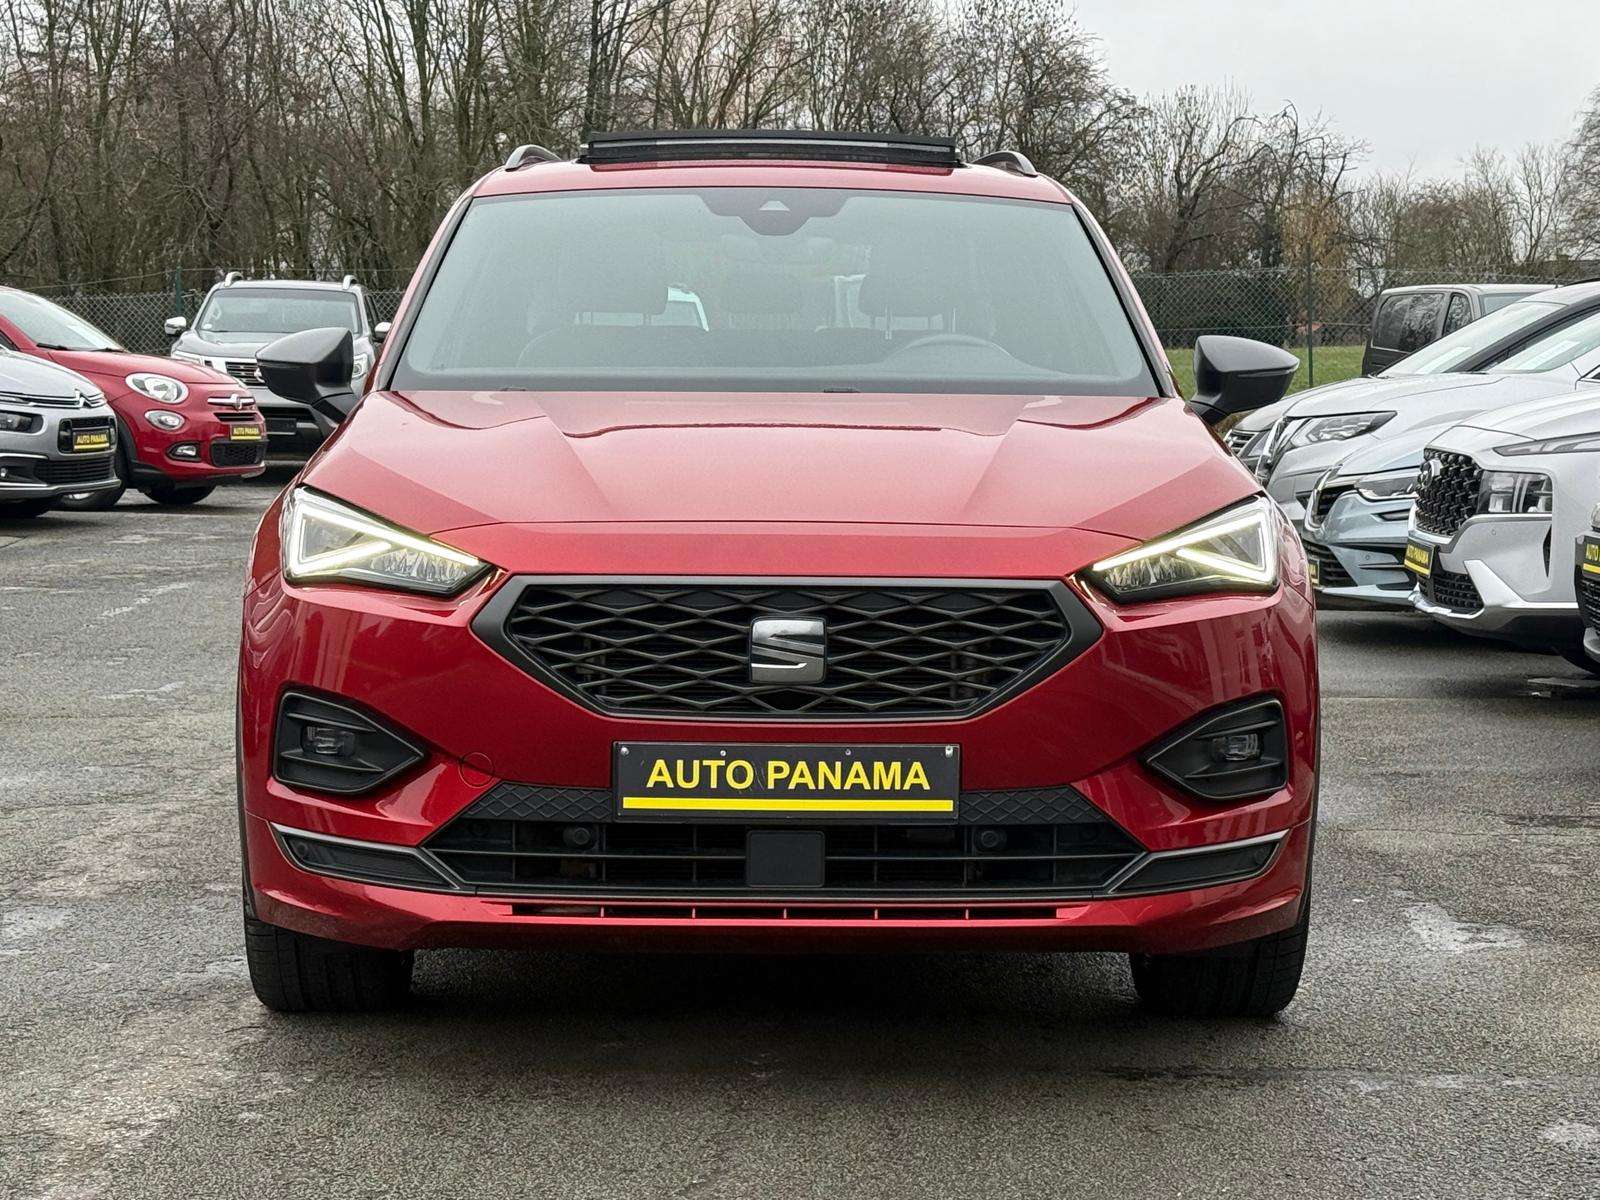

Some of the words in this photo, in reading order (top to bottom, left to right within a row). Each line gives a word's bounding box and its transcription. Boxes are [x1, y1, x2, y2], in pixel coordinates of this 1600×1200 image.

[77, 434, 90, 444] AUTO
[647, 759, 754, 789] AUTO
[767, 760, 930, 791] PANAMA
